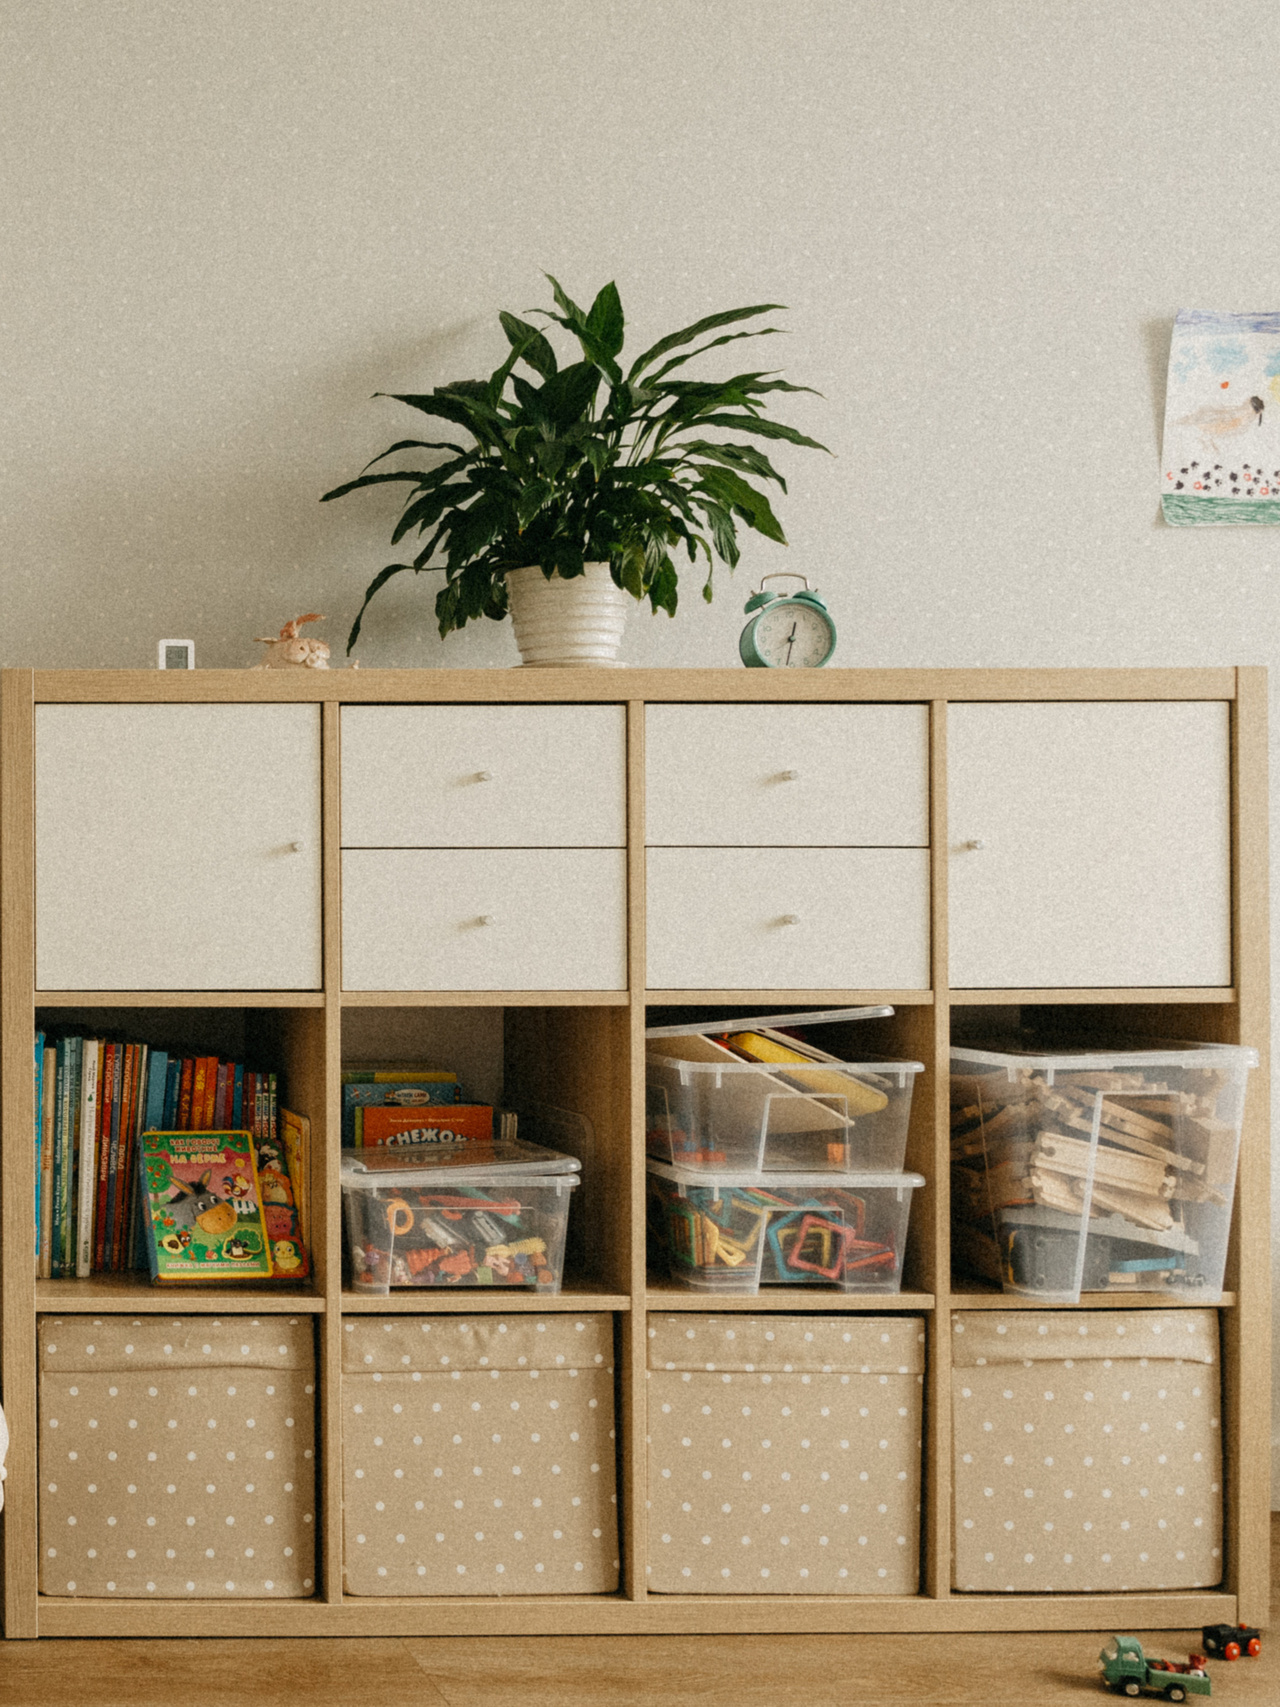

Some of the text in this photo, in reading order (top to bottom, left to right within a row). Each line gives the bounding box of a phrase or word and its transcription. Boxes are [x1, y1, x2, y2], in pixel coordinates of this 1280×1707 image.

[170, 1138, 184, 1146] КАК
[175, 1145, 218, 1153] ЖИВОТНЫЕ
[170, 1154, 187, 1164] НА
